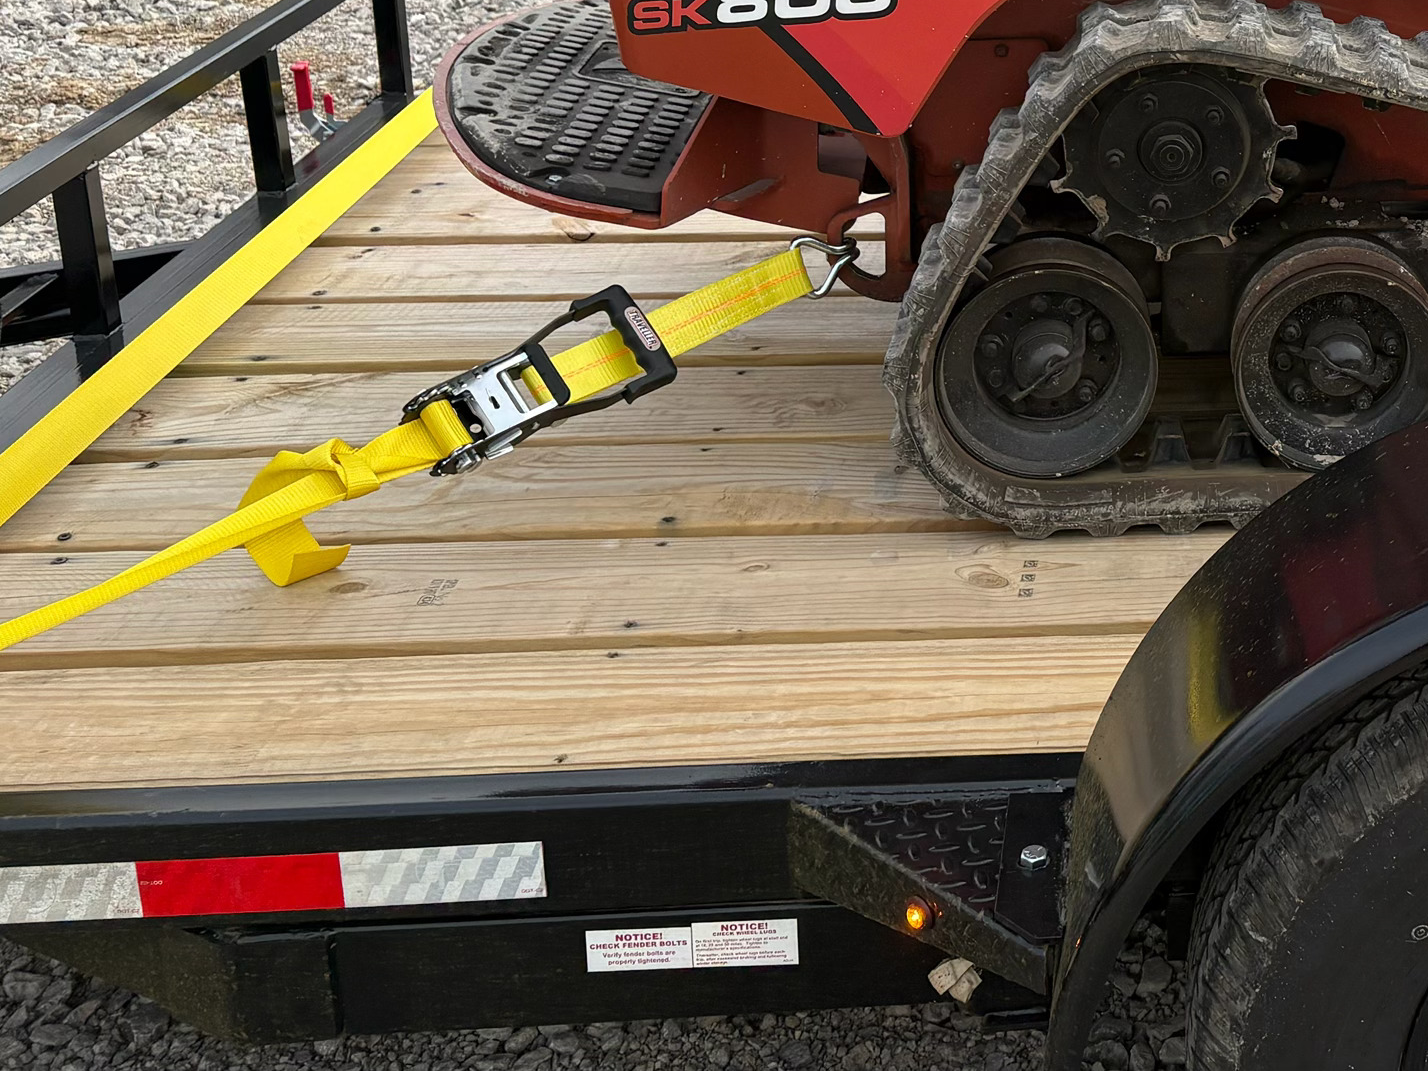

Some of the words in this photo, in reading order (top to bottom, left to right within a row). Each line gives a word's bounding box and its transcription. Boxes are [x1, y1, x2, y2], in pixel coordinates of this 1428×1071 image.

[629, 310, 658, 346] TRAVELLER
[720, 922, 768, 931] NOTICE!
[615, 932, 663, 942] NOTICE!
[622, 941, 657, 949] FENDER
[659, 939, 688, 947] BOLTS
